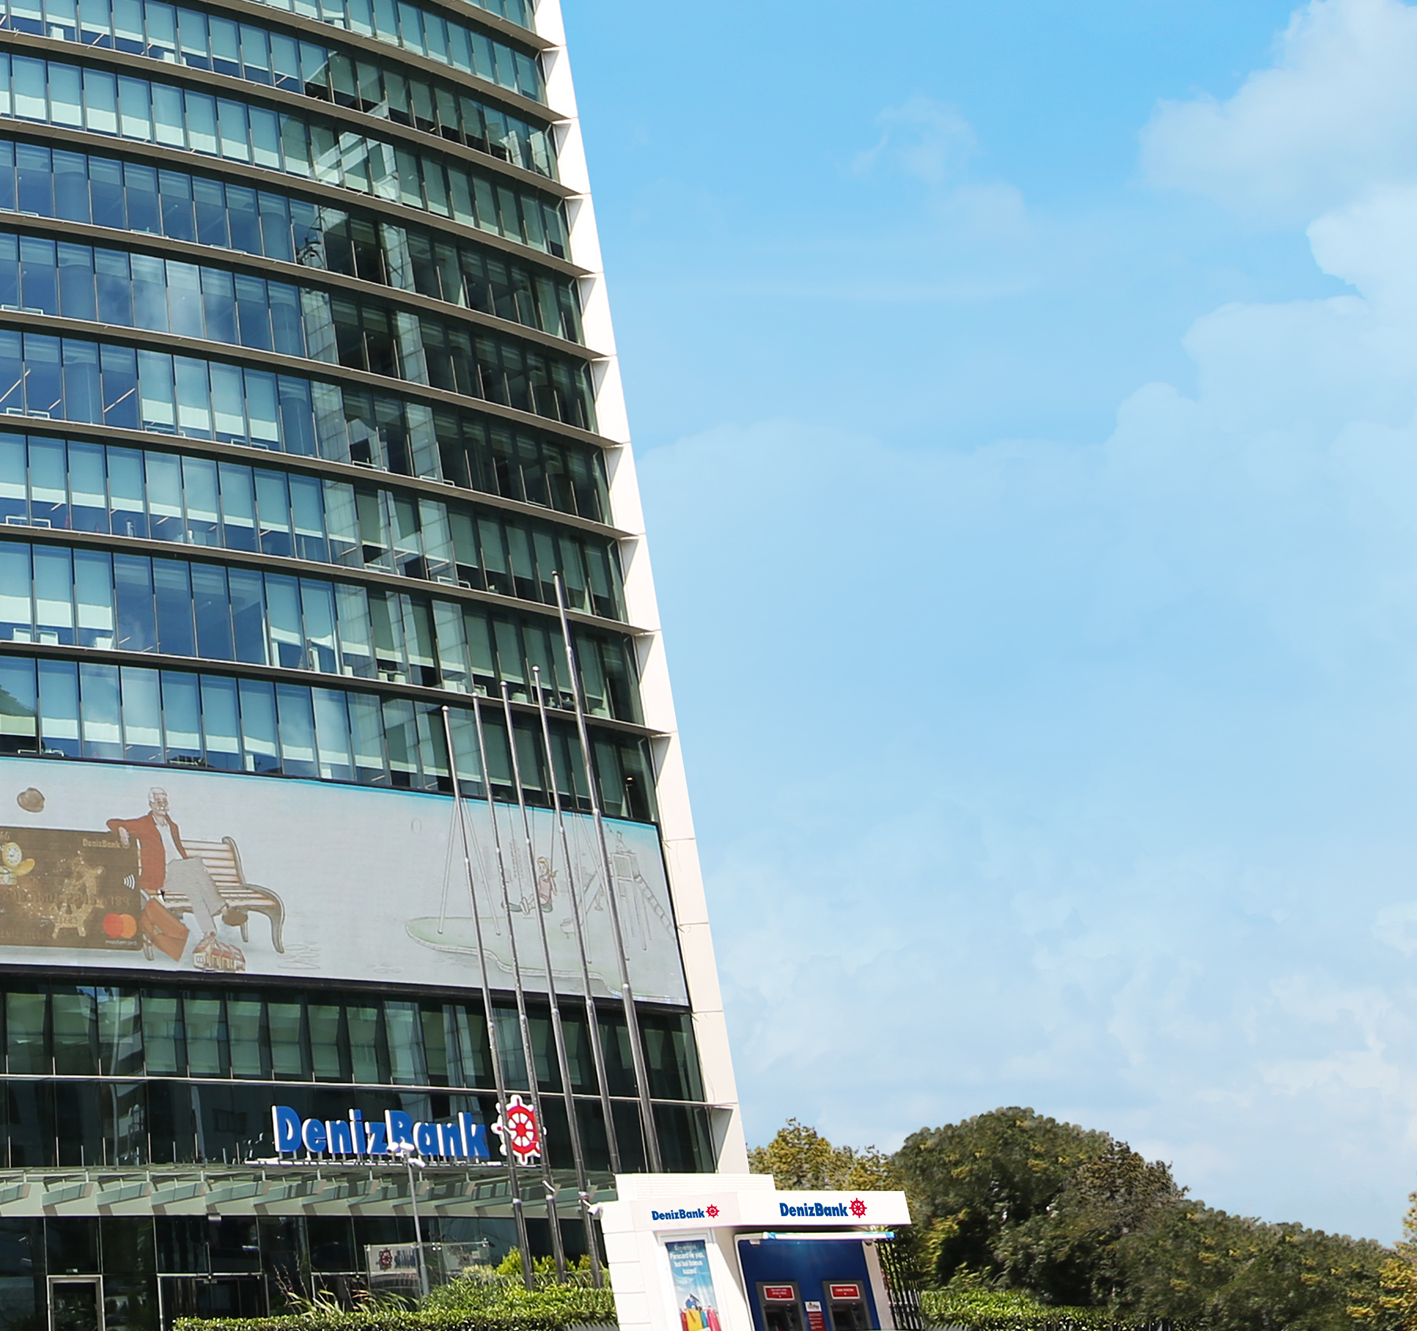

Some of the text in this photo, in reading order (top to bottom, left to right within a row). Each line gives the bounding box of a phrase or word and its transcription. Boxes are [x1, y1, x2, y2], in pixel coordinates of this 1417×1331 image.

[272, 1105, 490, 1157] DenizBank
[651, 1208, 705, 1221] DenizBank
[779, 1202, 849, 1217] DenizBank
